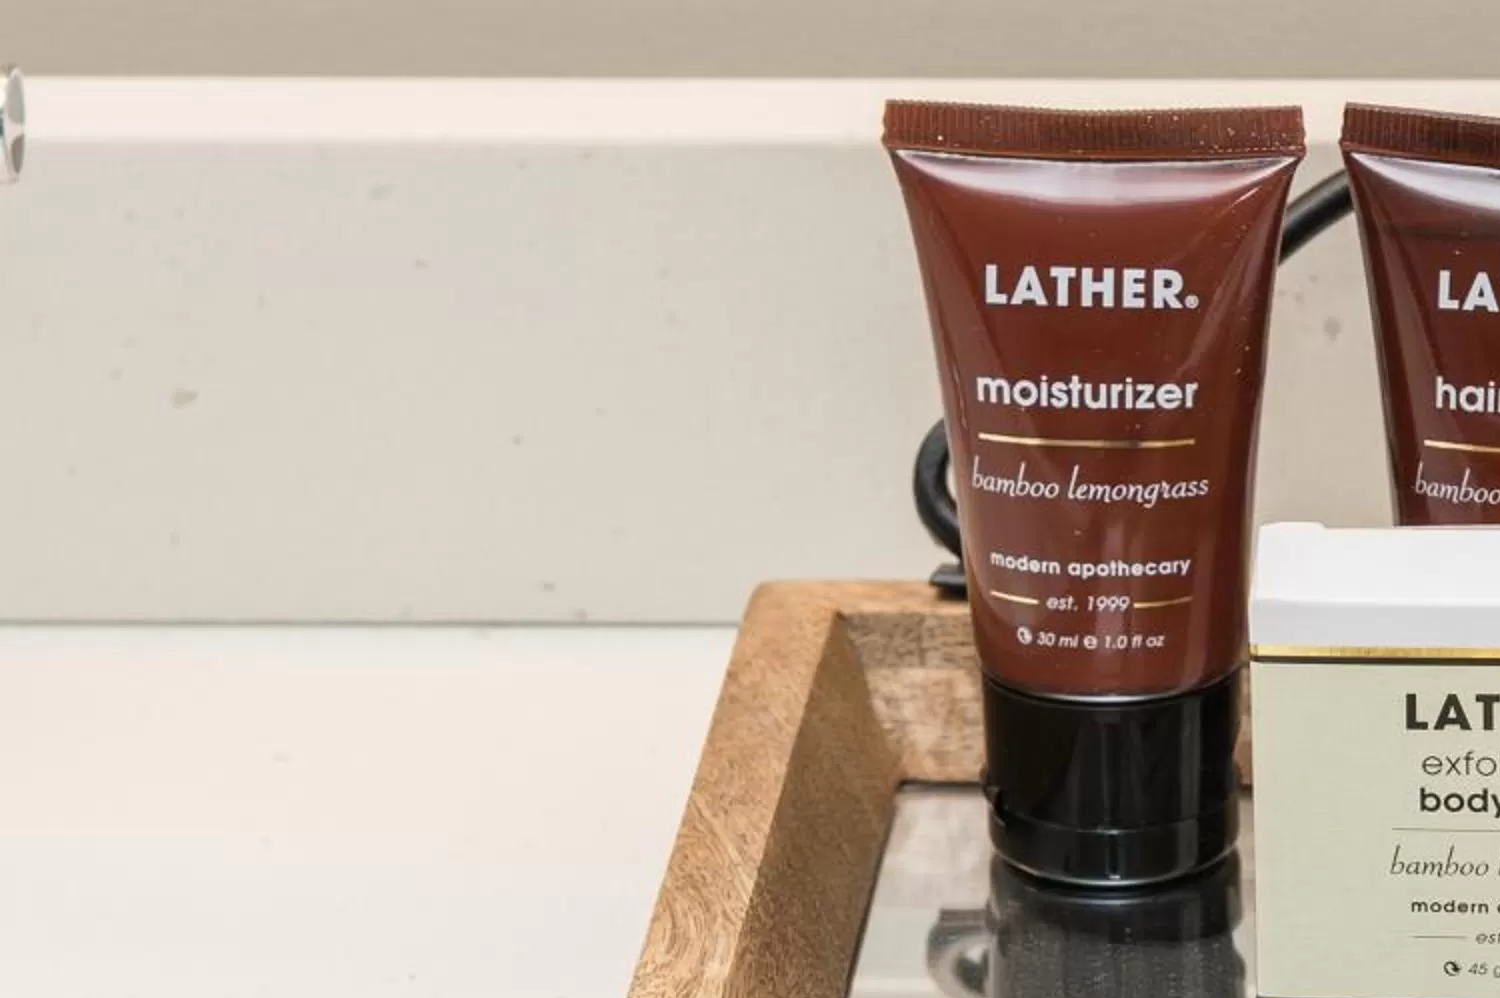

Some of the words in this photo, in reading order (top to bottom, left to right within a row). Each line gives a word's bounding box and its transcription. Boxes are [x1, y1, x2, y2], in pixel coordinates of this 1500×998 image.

[976, 375, 1198, 410] moisturizer
[971, 456, 1060, 499] bamboo
[1066, 464, 1210, 508] lemongrass
[989, 551, 1061, 575] modern
[1067, 558, 1192, 580] apothecary
[1046, 596, 1079, 612] est.
[1086, 595, 1131, 612] 1999
[1036, 631, 1057, 646] 30
[1058, 633, 1079, 647] ml
[1104, 634, 1128, 649] 1.0
[1130, 634, 1143, 648] fl
[1145, 634, 1166, 647] oz
[1390, 845, 1490, 880] bamboo
[1411, 899, 1489, 915] modern
[1467, 962, 1489, 976] 45
